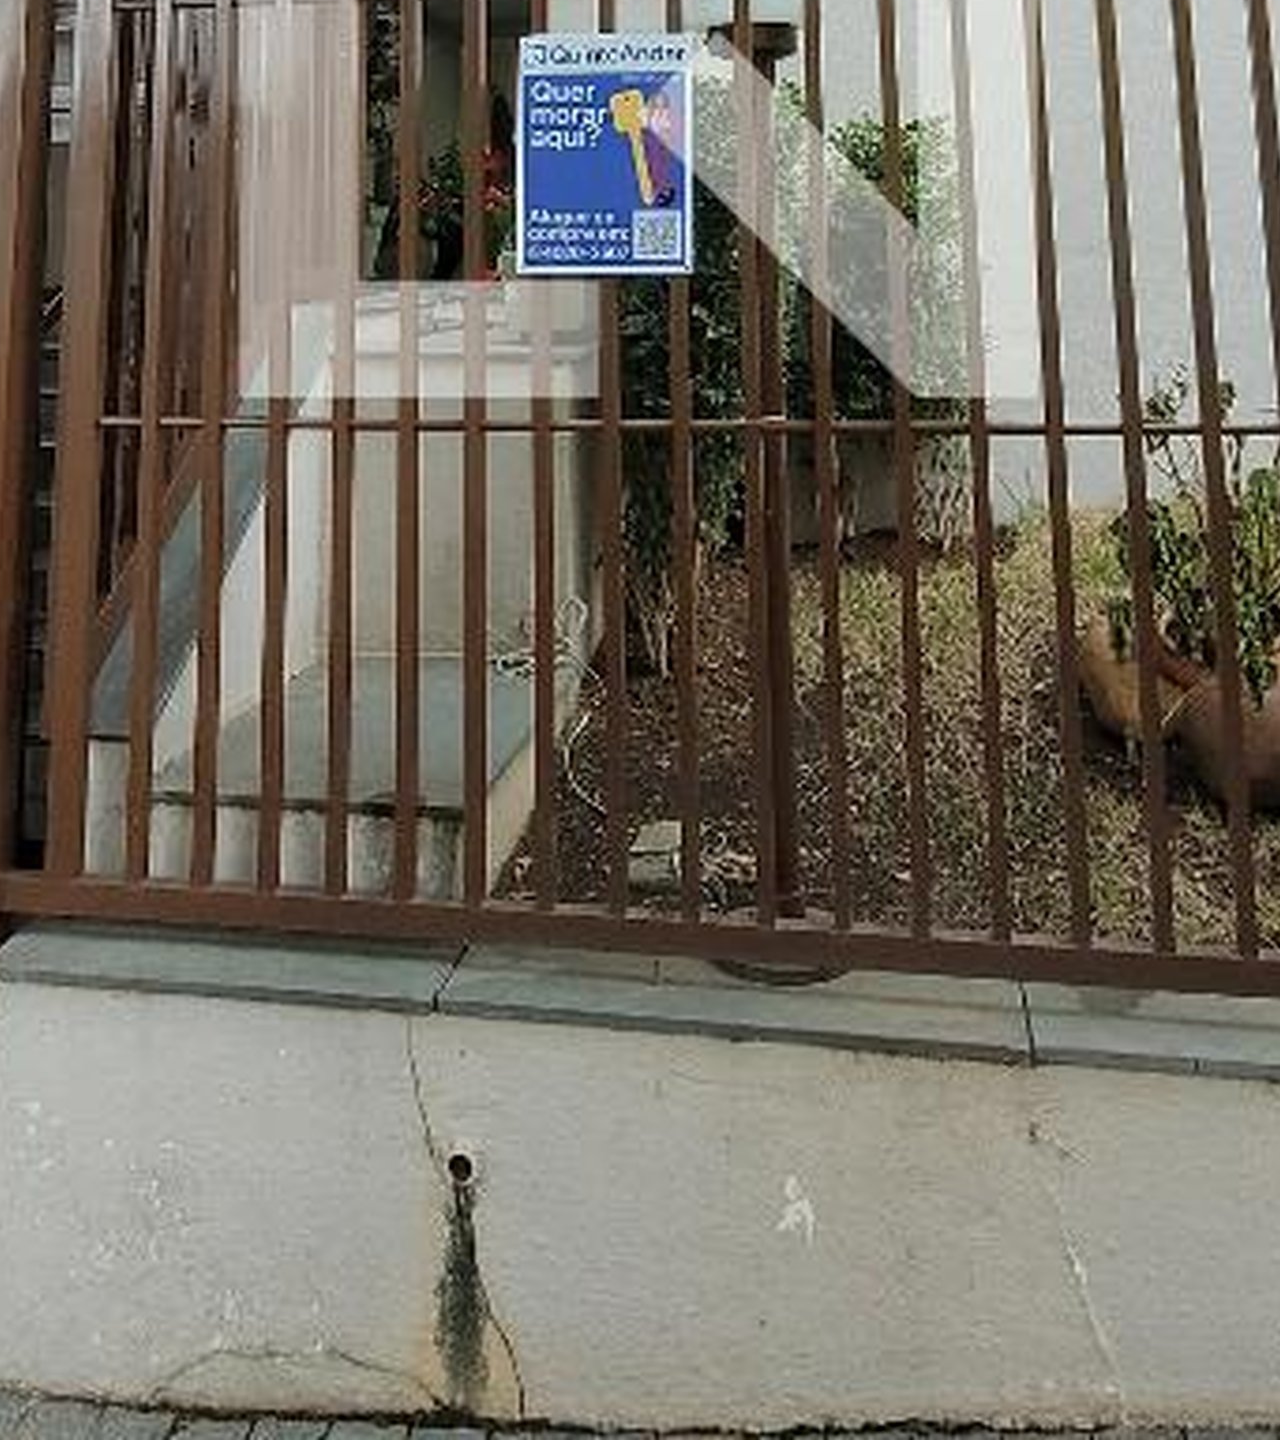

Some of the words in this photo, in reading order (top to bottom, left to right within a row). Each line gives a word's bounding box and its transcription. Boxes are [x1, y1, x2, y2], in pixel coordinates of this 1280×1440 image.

[530, 79, 596, 103] Quer
[530, 107, 607, 126] morar
[530, 125, 603, 151] aqui?
